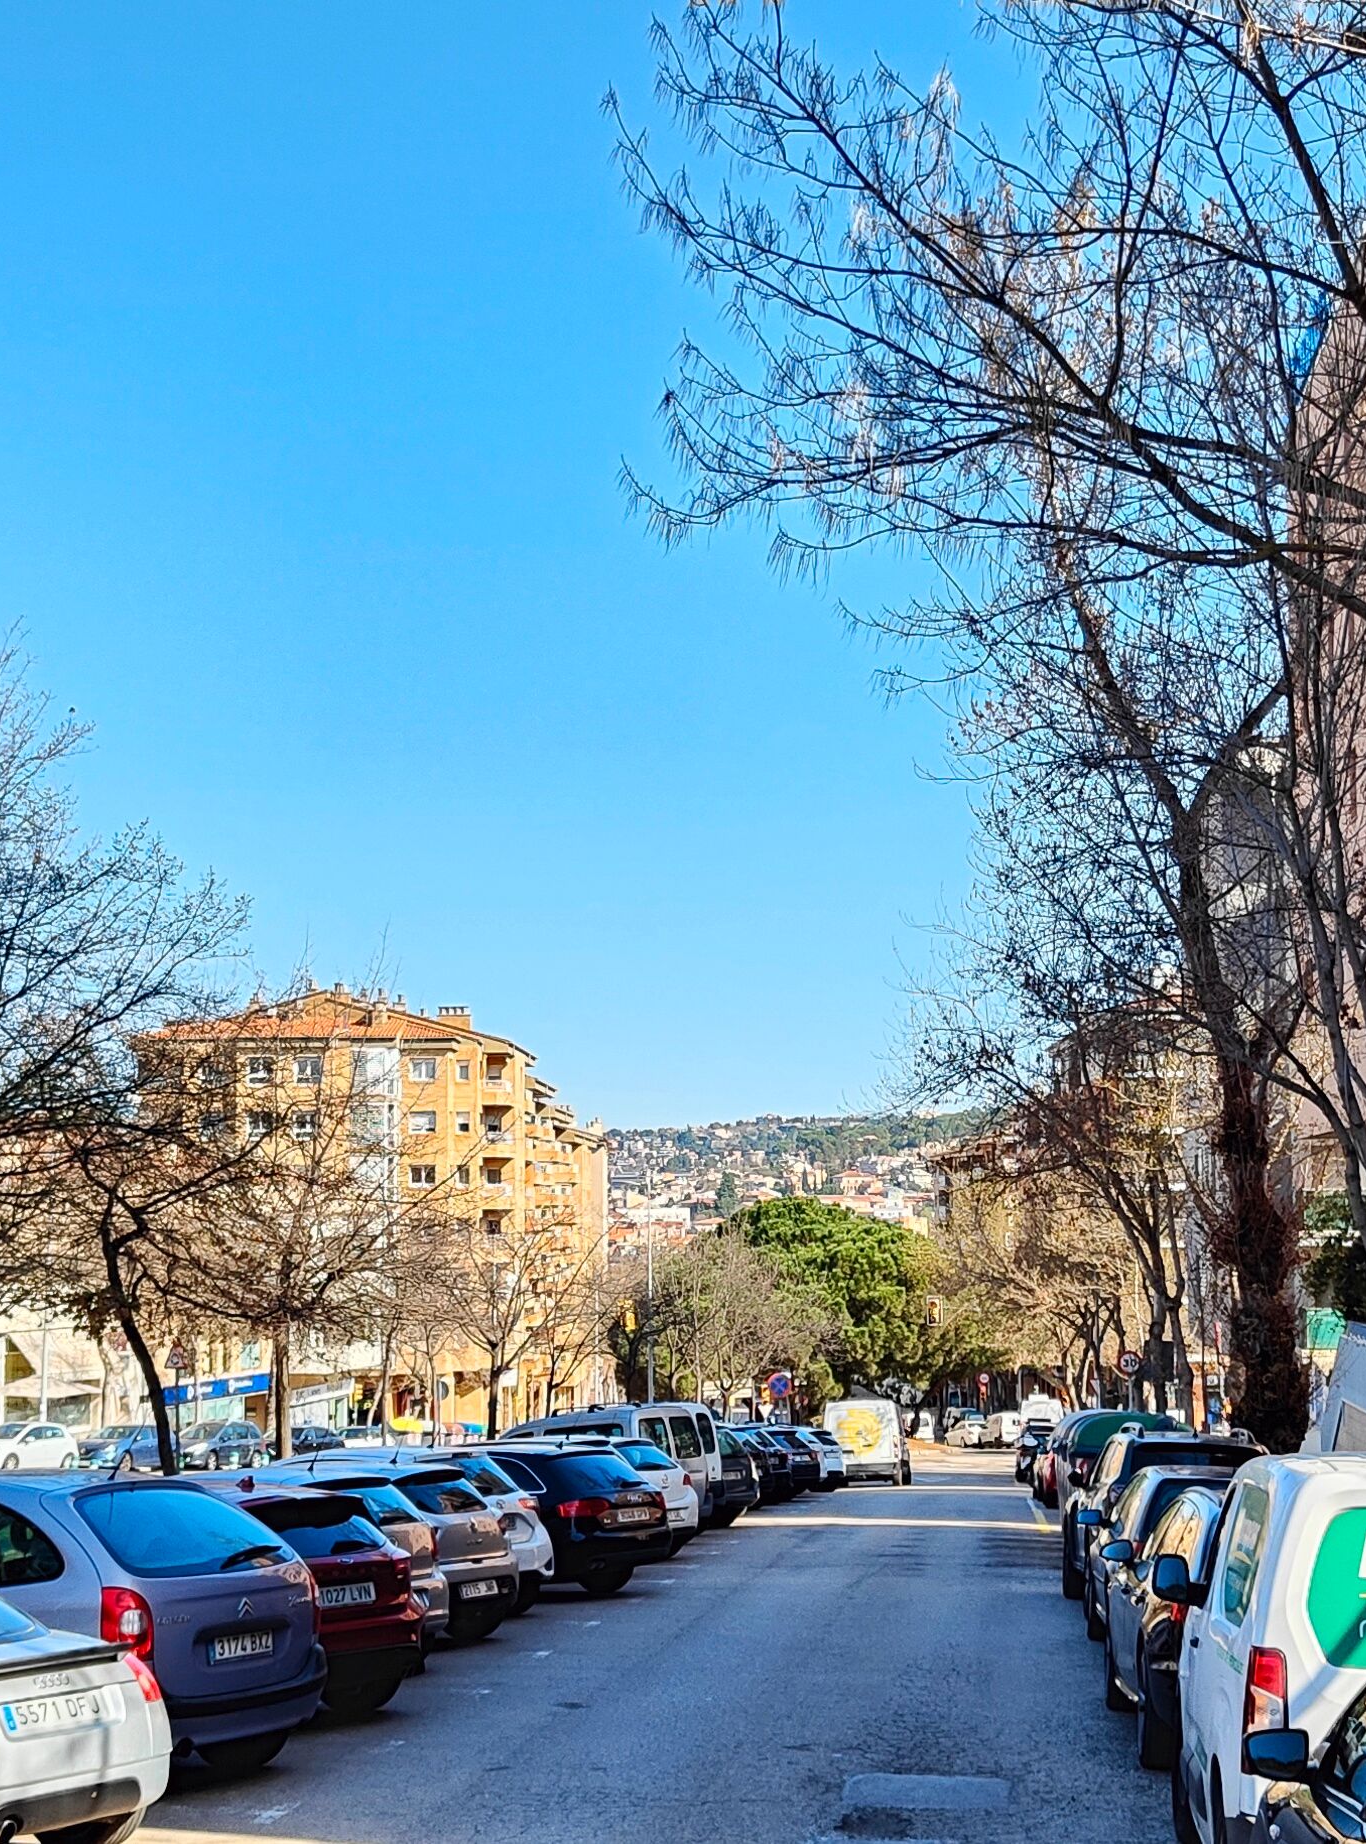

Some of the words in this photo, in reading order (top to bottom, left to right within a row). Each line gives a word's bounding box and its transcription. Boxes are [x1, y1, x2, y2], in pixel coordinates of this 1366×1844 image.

[1123, 1358, 1138, 1369] 30
[320, 1588, 346, 1605] 1027
[349, 1585, 372, 1601] LYN
[218, 1635, 248, 1658] 3174
[251, 1631, 271, 1652] BXZ
[15, 1701, 62, 1726] 5571
